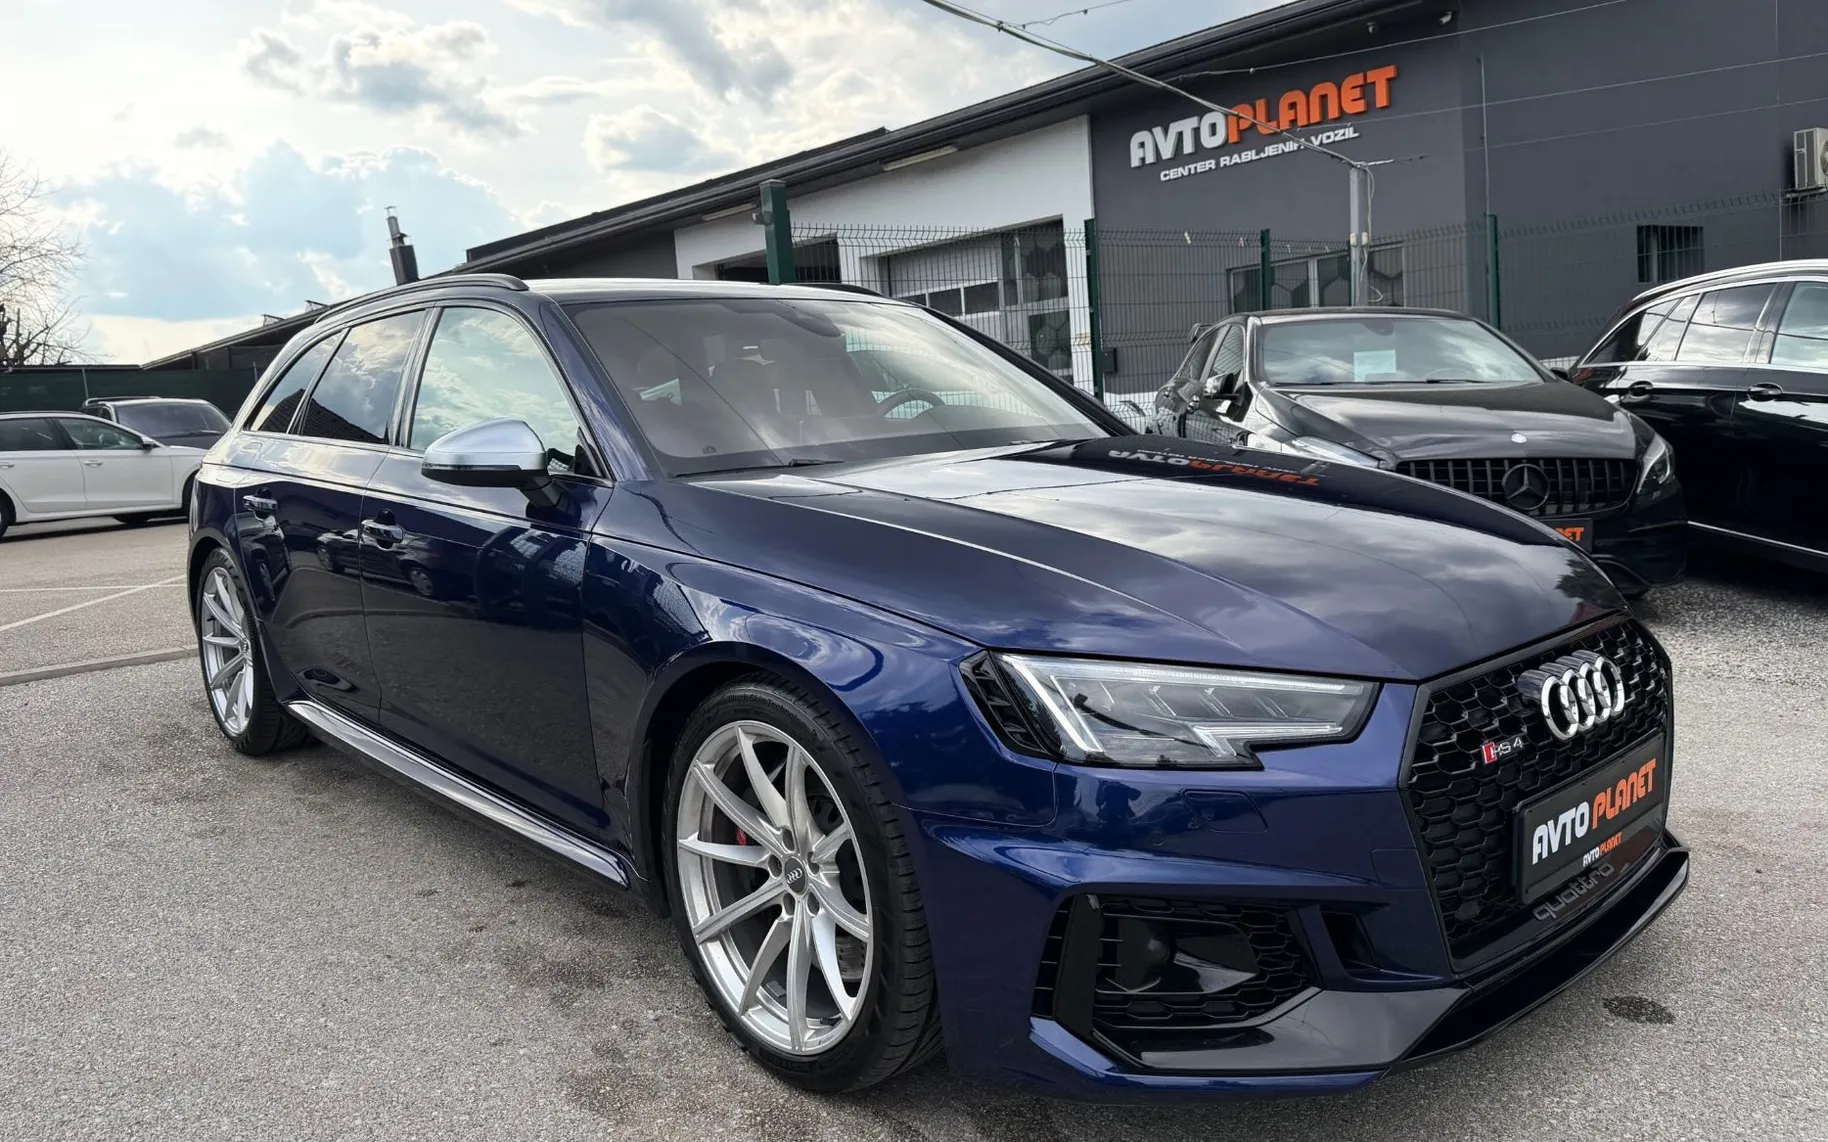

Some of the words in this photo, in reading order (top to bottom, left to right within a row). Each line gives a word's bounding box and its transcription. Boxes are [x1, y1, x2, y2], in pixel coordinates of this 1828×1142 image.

[1160, 159, 1216, 181] CENTER
[1310, 126, 1360, 146] VOZIL
[1532, 801, 1590, 865] AVTO
[1592, 758, 1656, 830] PLANET
[1532, 862, 1615, 921] quattro
